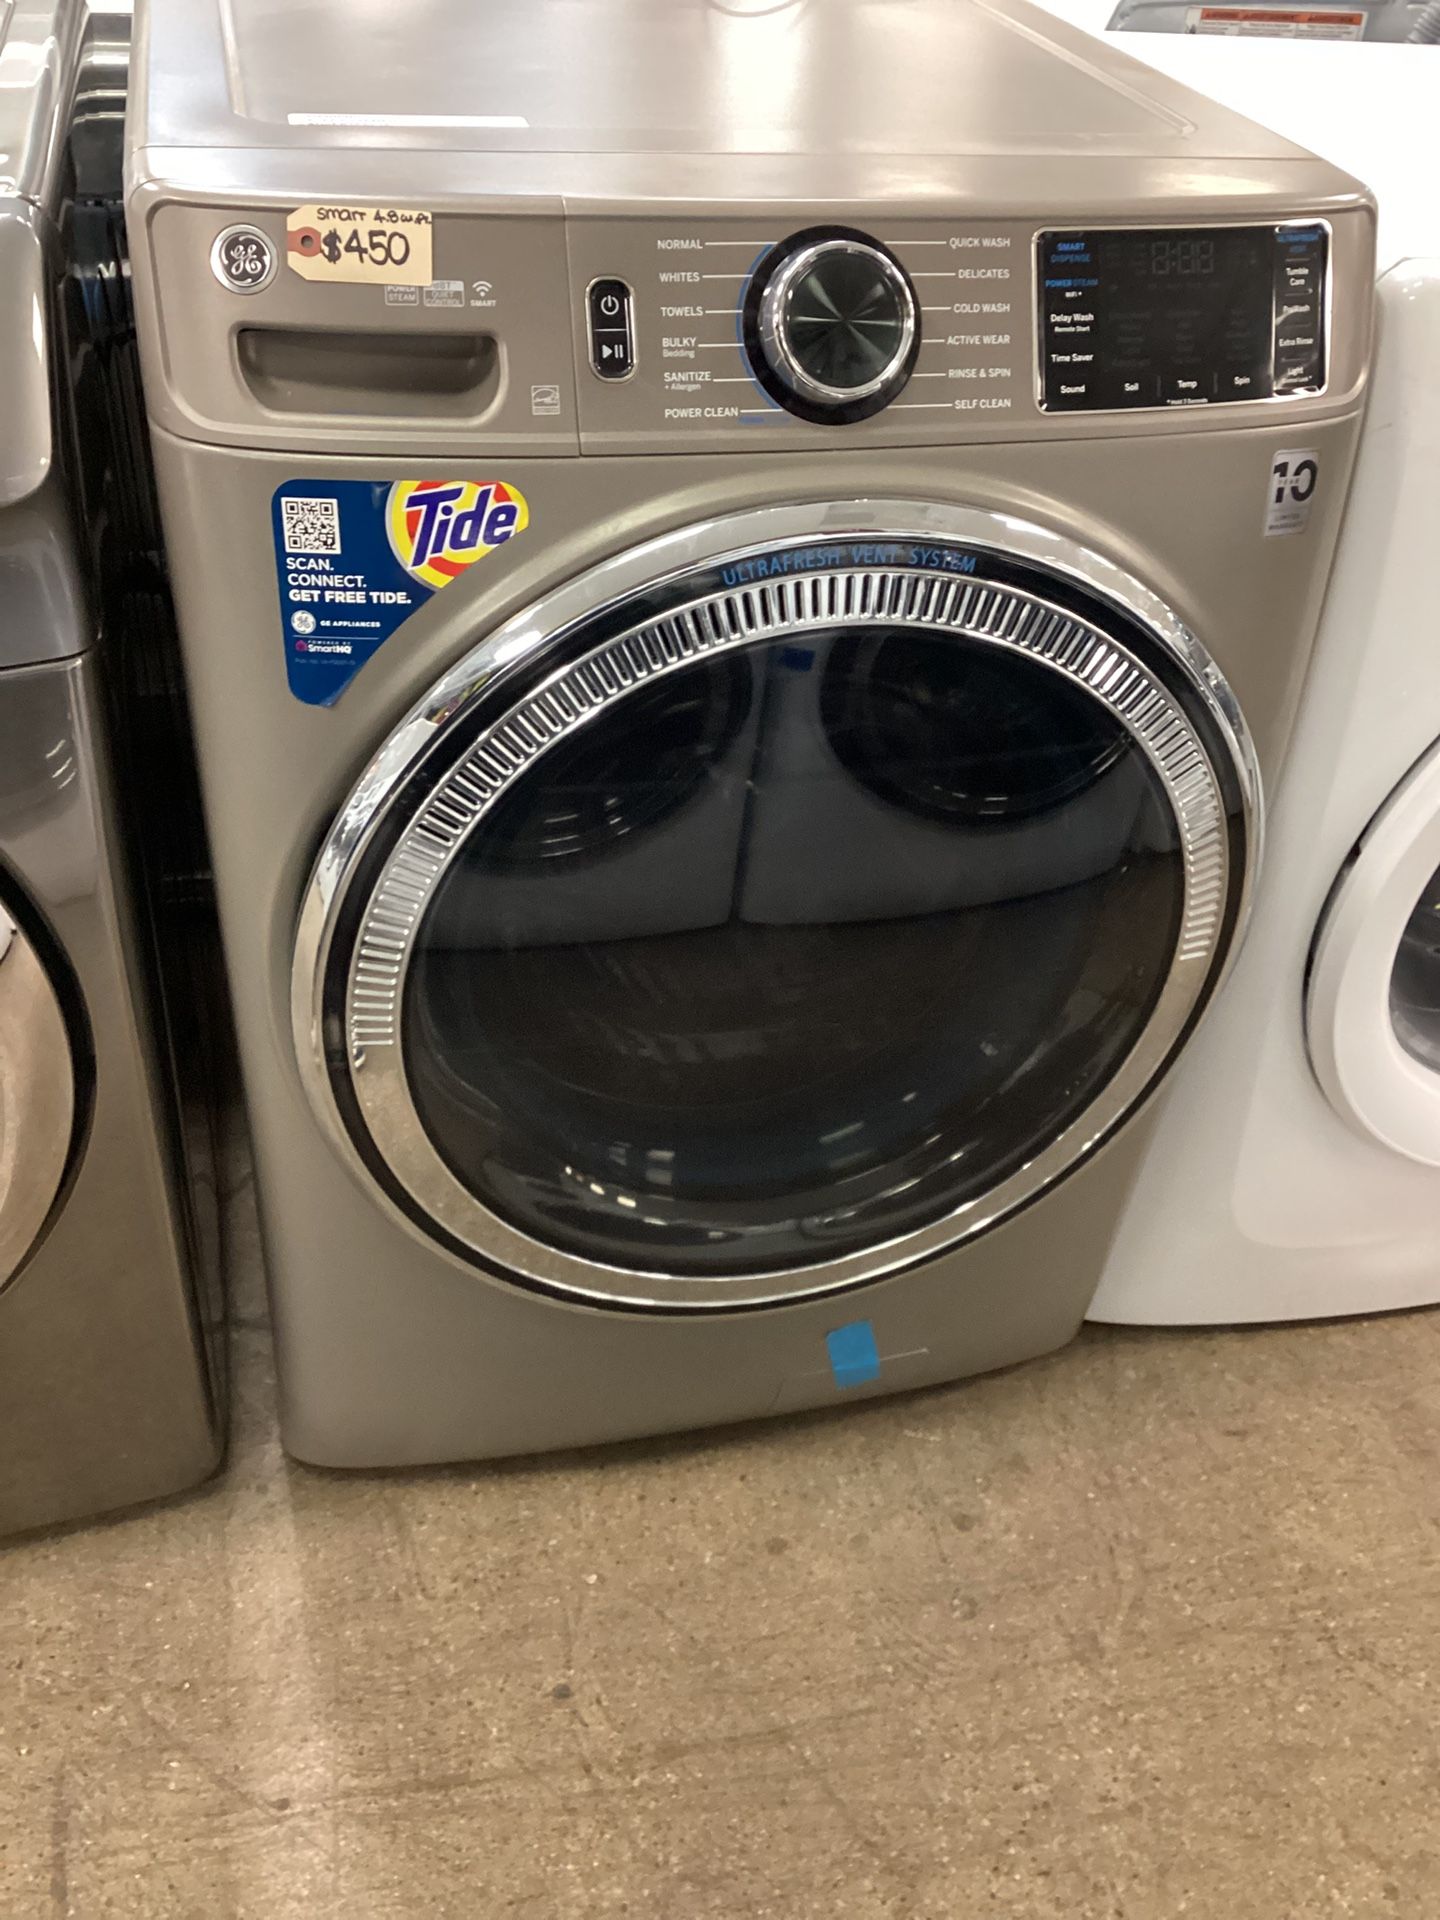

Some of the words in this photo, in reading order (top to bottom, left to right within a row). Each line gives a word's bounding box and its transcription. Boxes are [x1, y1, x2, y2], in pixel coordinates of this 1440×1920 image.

[373, 209, 399, 224] 4.8
[321, 228, 410, 265] $450
[656, 239, 703, 250] NORMAL
[949, 237, 980, 250] QUICK
[982, 237, 1011, 248] WASH
[659, 271, 700, 283] WHITES
[957, 268, 1011, 279] DELICATES
[388, 293, 416, 302] STEAM
[470, 299, 497, 307] SMART
[660, 305, 704, 317] TOWELS
[953, 303, 980, 313] COLD
[981, 303, 1011, 313] WASH
[1050, 313, 1072, 324] Delay
[1073, 313, 1095, 322] Wash
[662, 337, 697, 348] BULKY
[947, 335, 980, 345] ACTIVE
[982, 334, 1011, 344] WEAR
[662, 348, 696, 359] Bedding
[1051, 354, 1071, 362] Time
[1072, 353, 1094, 362] Saver
[664, 371, 712, 382] SANITIZE
[948, 369, 977, 379] RINSE
[979, 368, 987, 378] &
[988, 368, 1012, 378] SPIN
[1124, 382, 1139, 391] Soil
[1177, 380, 1198, 389] Temp
[1234, 376, 1251, 386] Spin
[671, 383, 702, 393] Allergen
[1060, 384, 1086, 394] Sound
[954, 399, 978, 410] SELF
[979, 398, 1012, 409] CLEAN
[664, 408, 702, 418] POWER
[703, 407, 739, 417] CLEAN
[1273, 459, 1318, 503] 10
[405, 484, 519, 568] Tide
[286, 557, 335, 571] SCAN.
[722, 548, 841, 586] ULTRAFRESH
[851, 545, 897, 564] VENT
[908, 546, 977, 573] SYSTEM
[287, 573, 367, 588] CONNECT.
[289, 589, 321, 602] GET
[324, 590, 367, 604] FREE
[369, 591, 412, 605] TIDE.
[307, 644, 352, 655] SmartHQ
